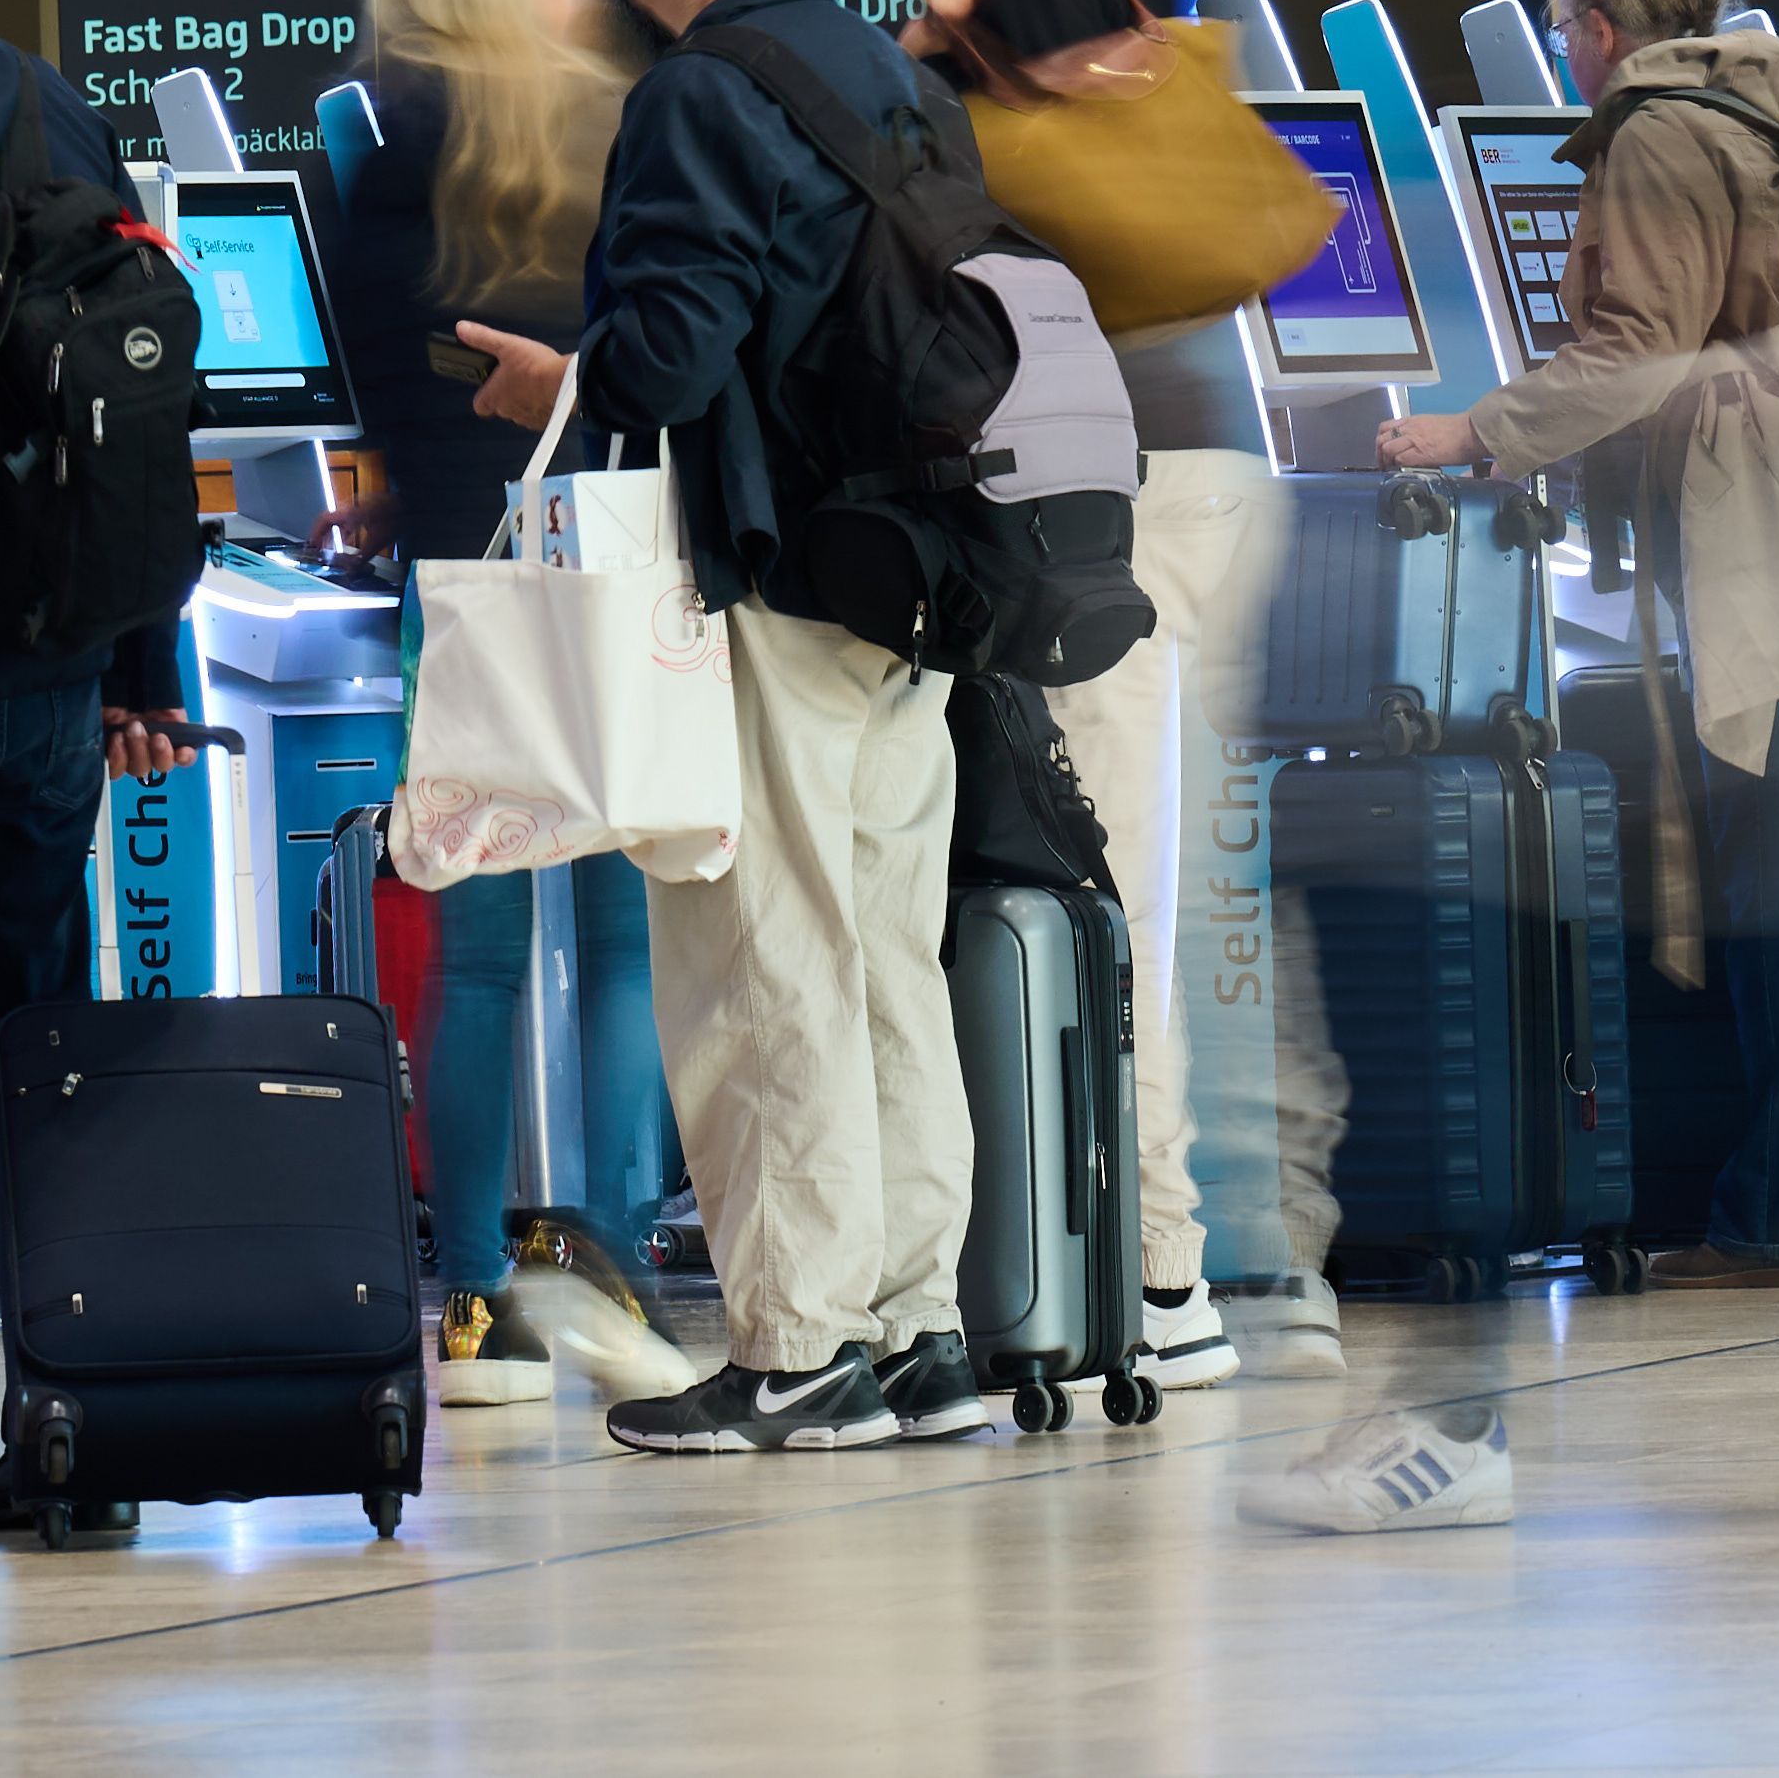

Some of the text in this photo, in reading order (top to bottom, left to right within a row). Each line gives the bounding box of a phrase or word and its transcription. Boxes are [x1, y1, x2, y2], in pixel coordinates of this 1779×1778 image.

[83, 11, 357, 60] Fast Bag Drop
[223, 66, 245, 102] 2
[234, 126, 326, 156] päcklab
[1481, 148, 1501, 164] BER
[204, 238, 256, 255] Self-Service
[125, 770, 171, 999] Self Che
[1207, 741, 1261, 1006] Self Che
